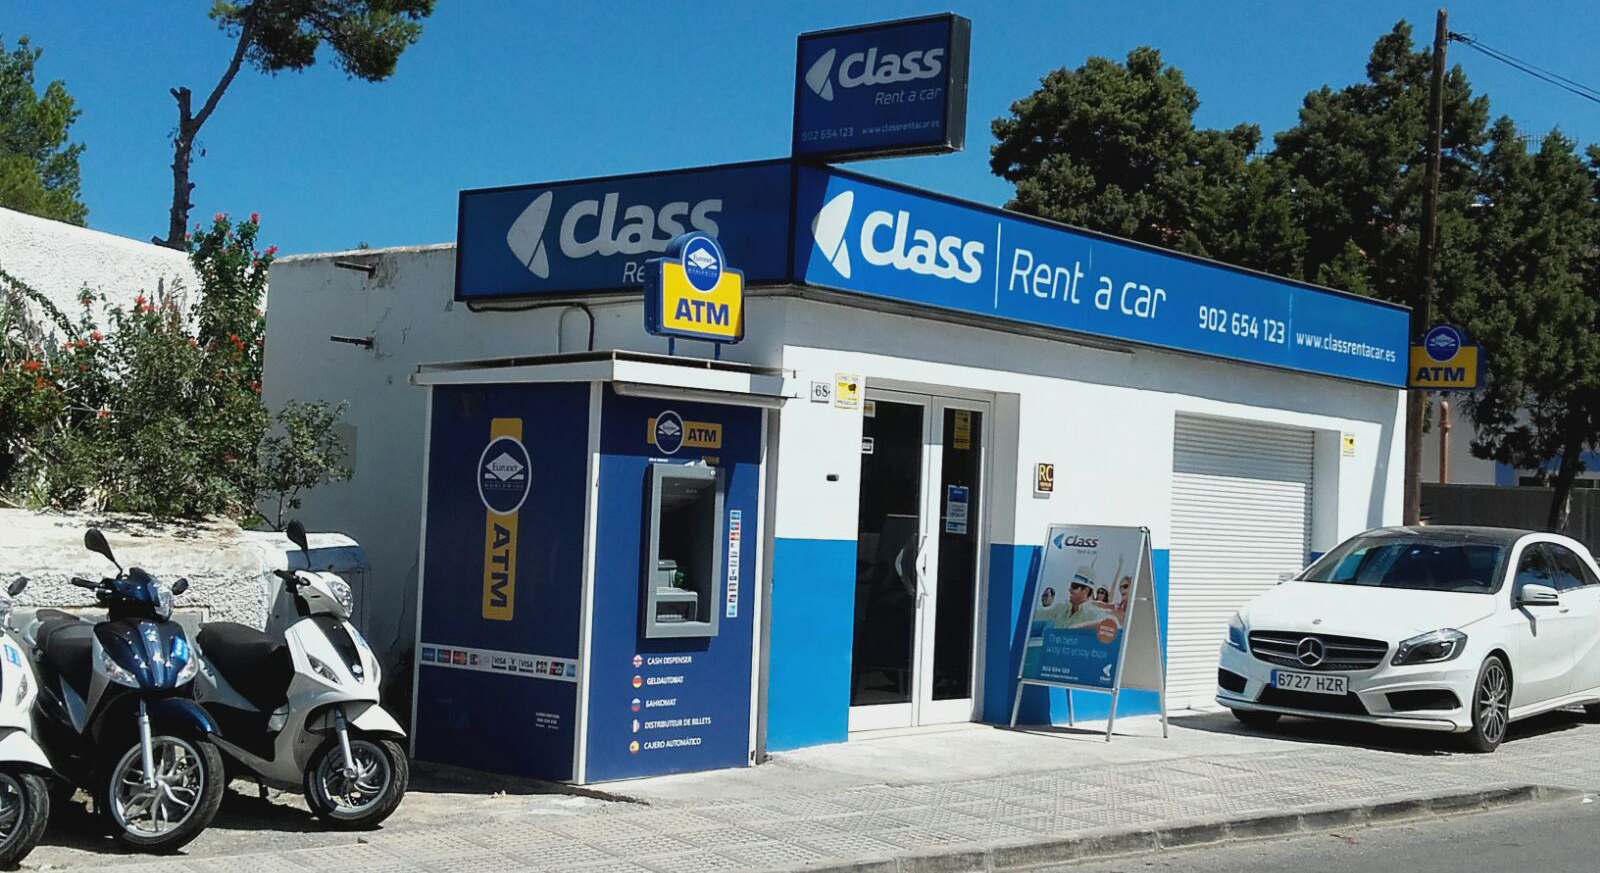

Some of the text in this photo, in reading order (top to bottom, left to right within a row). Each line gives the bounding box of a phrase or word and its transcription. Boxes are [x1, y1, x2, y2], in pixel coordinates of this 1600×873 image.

[838, 47, 944, 88] Class
[874, 87, 942, 105] Rent a car
[802, 131, 818, 142] 902
[820, 129, 837, 139] 654
[839, 127, 854, 137] 123
[559, 192, 722, 258] Class
[622, 261, 645, 283] Re
[860, 210, 1396, 363] Class Rent a car 902 654 123 www.classrentacar.es
[675, 298, 729, 326] ATM
[1415, 367, 1465, 382] ATM
[688, 428, 717, 443] ATM
[1039, 465, 1054, 482] RC
[490, 522, 511, 608] ATM
[494, 657, 507, 665] VISA
[521, 660, 534, 668] VISA
[647, 656, 692, 665] CASH DISPENSER
[646, 676, 684, 685] GELDAUTOMAT
[1278, 673, 1344, 692] 6727 HZR
[644, 717, 711, 729] DISTRIBUTEUR DE BILLETS
[643, 742, 665, 750] CAJERO
